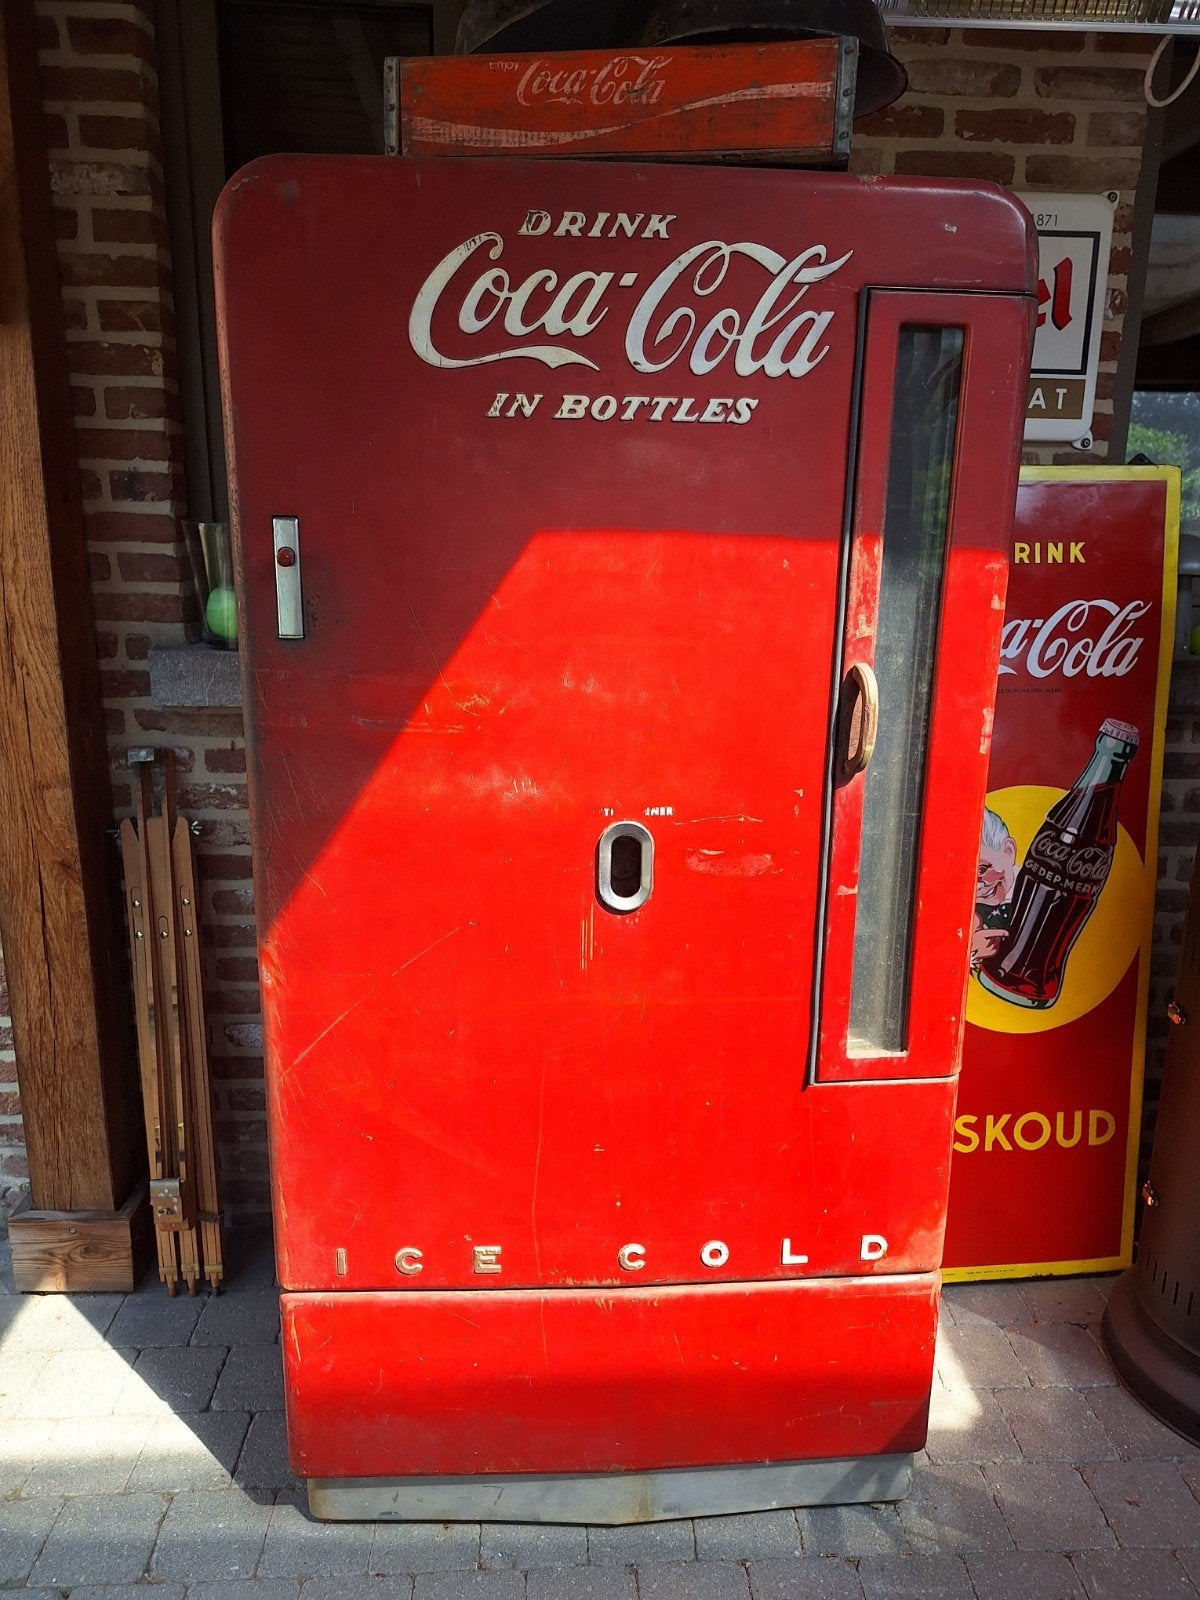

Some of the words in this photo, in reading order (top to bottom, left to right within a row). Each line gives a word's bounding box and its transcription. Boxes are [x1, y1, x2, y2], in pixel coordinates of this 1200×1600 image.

[516, 55, 673, 106] Coca-Cola
[517, 209, 677, 239] DRINK
[1031, 213, 1058, 227] 871
[408, 231, 853, 379] Coca-Cola
[485, 392, 543, 419] IN
[553, 394, 759, 424] BOTTLES
[1031, 830, 1113, 880] Coca-Cola
[336, 1245, 502, 1276] ICE
[617, 1234, 888, 1272] COLD
